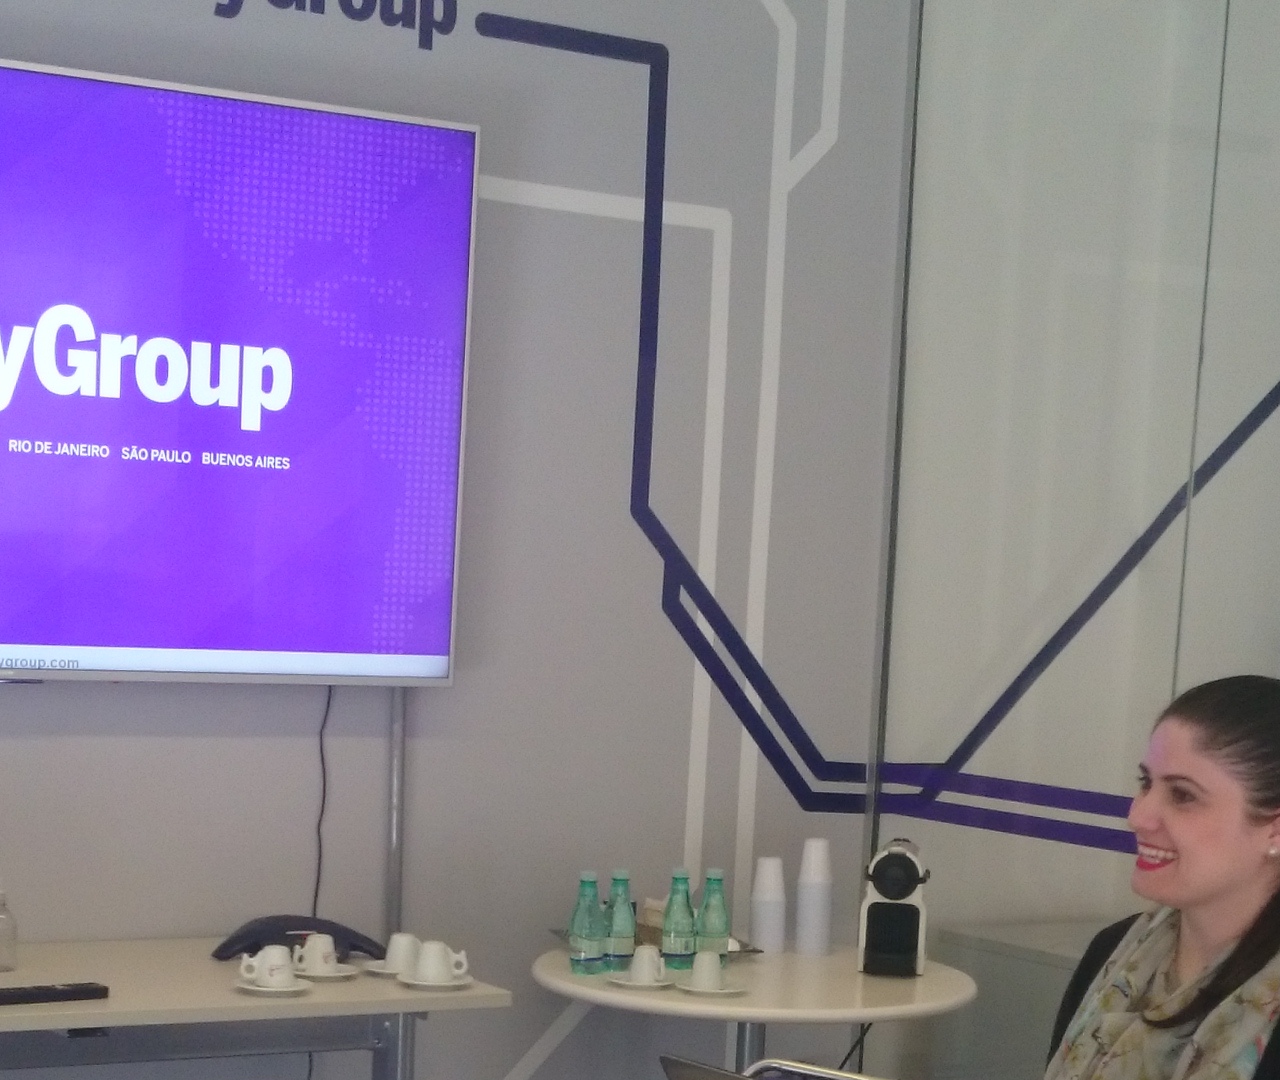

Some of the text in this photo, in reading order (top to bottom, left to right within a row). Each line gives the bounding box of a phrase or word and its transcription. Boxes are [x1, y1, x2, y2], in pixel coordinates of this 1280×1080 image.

[8, 438, 32, 453] RIO
[34, 440, 53, 454] DE
[54, 442, 110, 458] JANEIRO
[121, 443, 148, 460] SÃO
[150, 448, 191, 463] PAULO
[201, 451, 253, 467] BUENOS
[254, 455, 290, 469] AIRES
